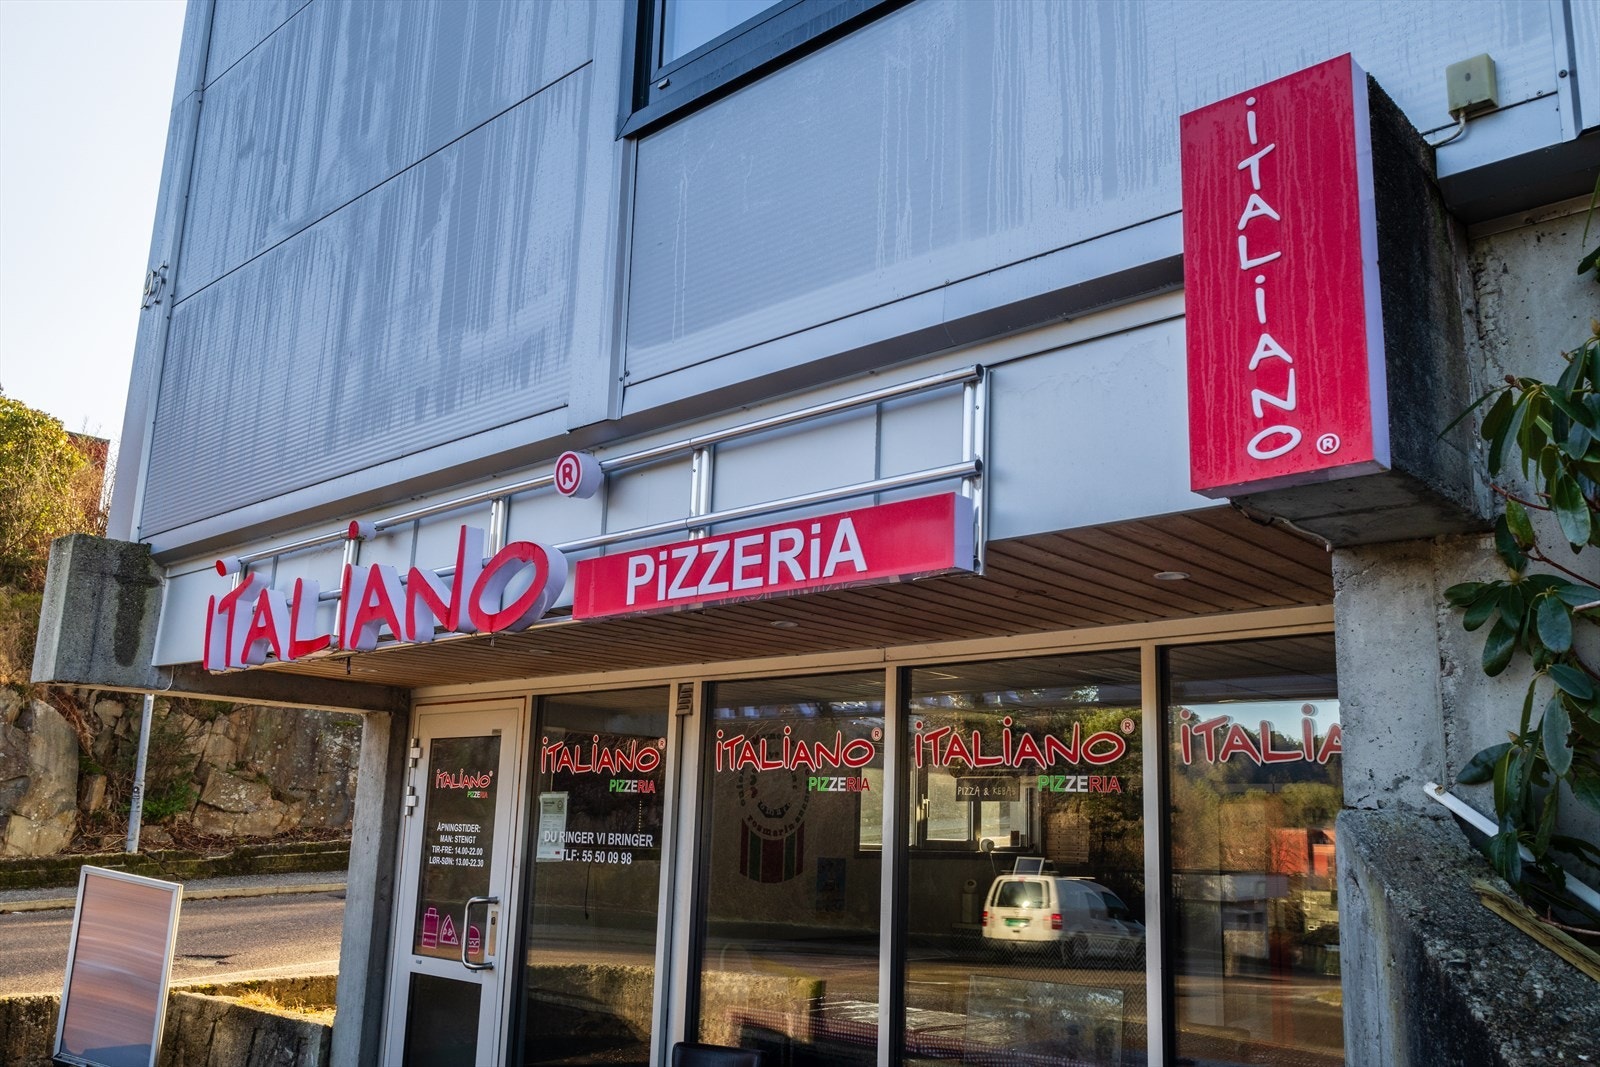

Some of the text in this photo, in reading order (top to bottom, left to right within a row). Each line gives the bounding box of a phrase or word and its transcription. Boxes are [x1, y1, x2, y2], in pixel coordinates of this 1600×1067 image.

[608, 779, 656, 794] PIZZERIA
[808, 776, 870, 792] PIZZERIA
[957, 786, 980, 797] PIZZA
[983, 787, 989, 796] &
[1037, 775, 1122, 793] PIZZERIA
[436, 821, 481, 833] ÅPNINGSTIDER:
[439, 834, 476, 844] MAN: STENGT
[544, 830, 654, 847] DU RINGER VI BRINGER
[561, 848, 580, 862] TLF:
[581, 850, 593, 863] 55
[594, 850, 606, 863] 50
[607, 851, 619, 864] 09
[620, 852, 632, 865] 98
